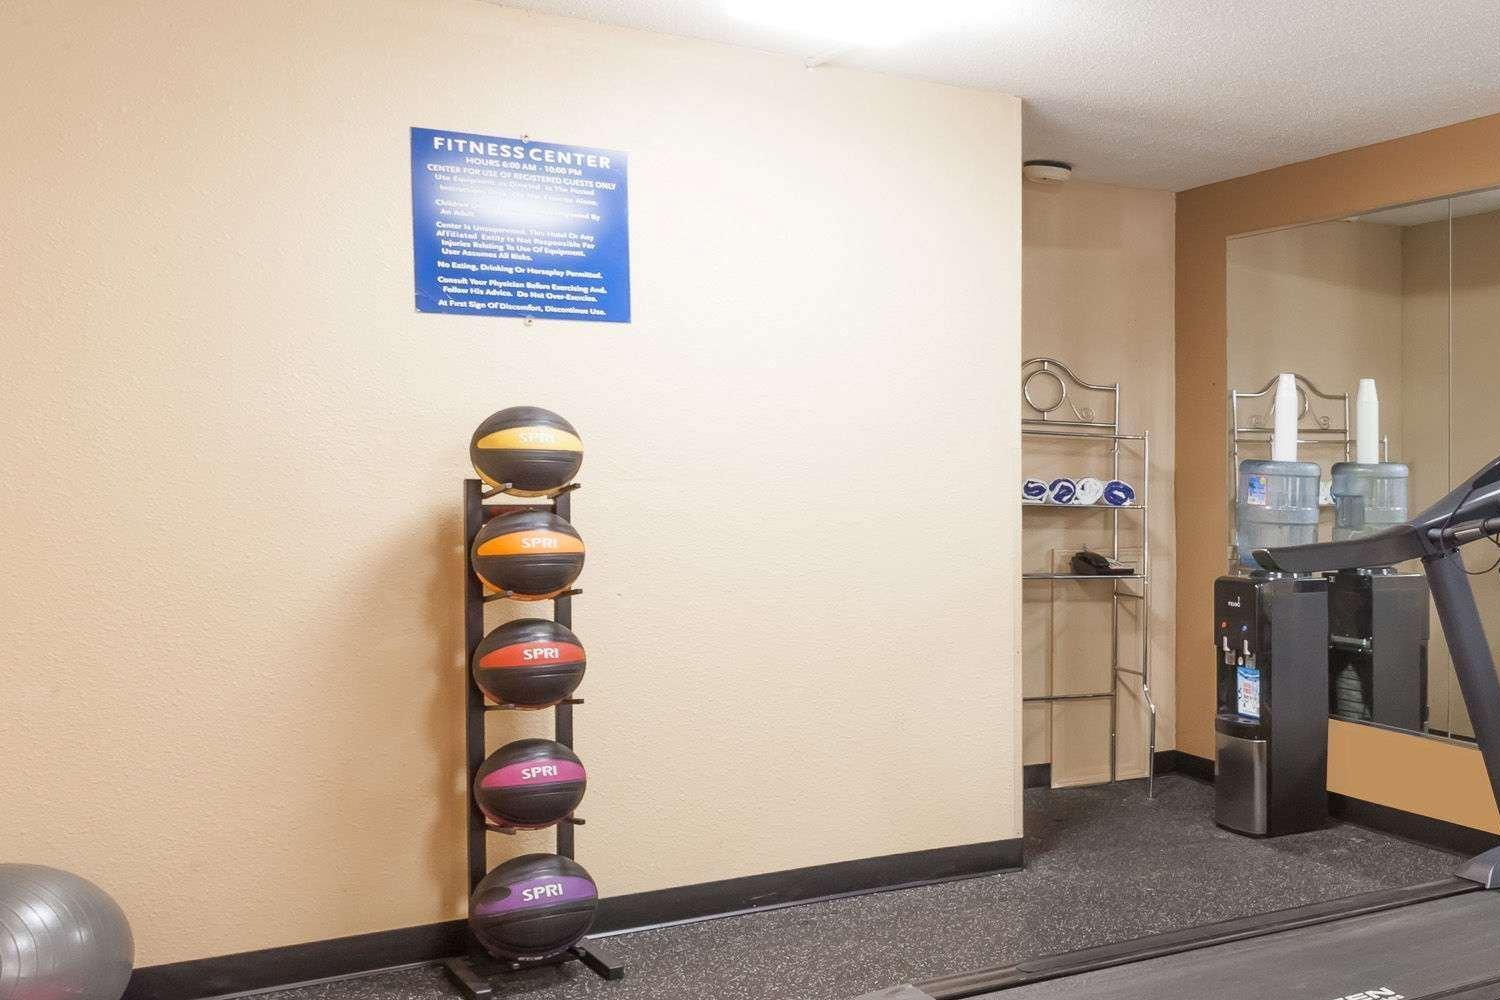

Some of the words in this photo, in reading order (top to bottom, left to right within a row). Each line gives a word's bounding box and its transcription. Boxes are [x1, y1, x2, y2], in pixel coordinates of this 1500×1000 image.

[433, 136, 523, 159] FITNESS
[529, 147, 610, 168] CENTER
[466, 157, 499, 167] HOURS
[522, 163, 537, 171] AM
[427, 163, 460, 174] CENTER
[463, 167, 480, 176] FOR
[482, 169, 497, 178] USE
[513, 172, 561, 184] REGISTERED
[563, 177, 594, 188] GUESTS
[595, 181, 615, 190] ONLY
[442, 247, 460, 255] User
[437, 260, 450, 268] No
[480, 263, 513, 274] Drinking
[437, 275, 468, 284] Consult
[469, 278, 487, 286] Your
[489, 279, 524, 289] Physician
[443, 286, 468, 294] Follow
[468, 301, 486, 309] Sign
[520, 536, 556, 549] SPRI
[522, 647, 559, 661] SPRI
[521, 765, 558, 780] SPRI
[521, 882, 563, 902] SPRI
